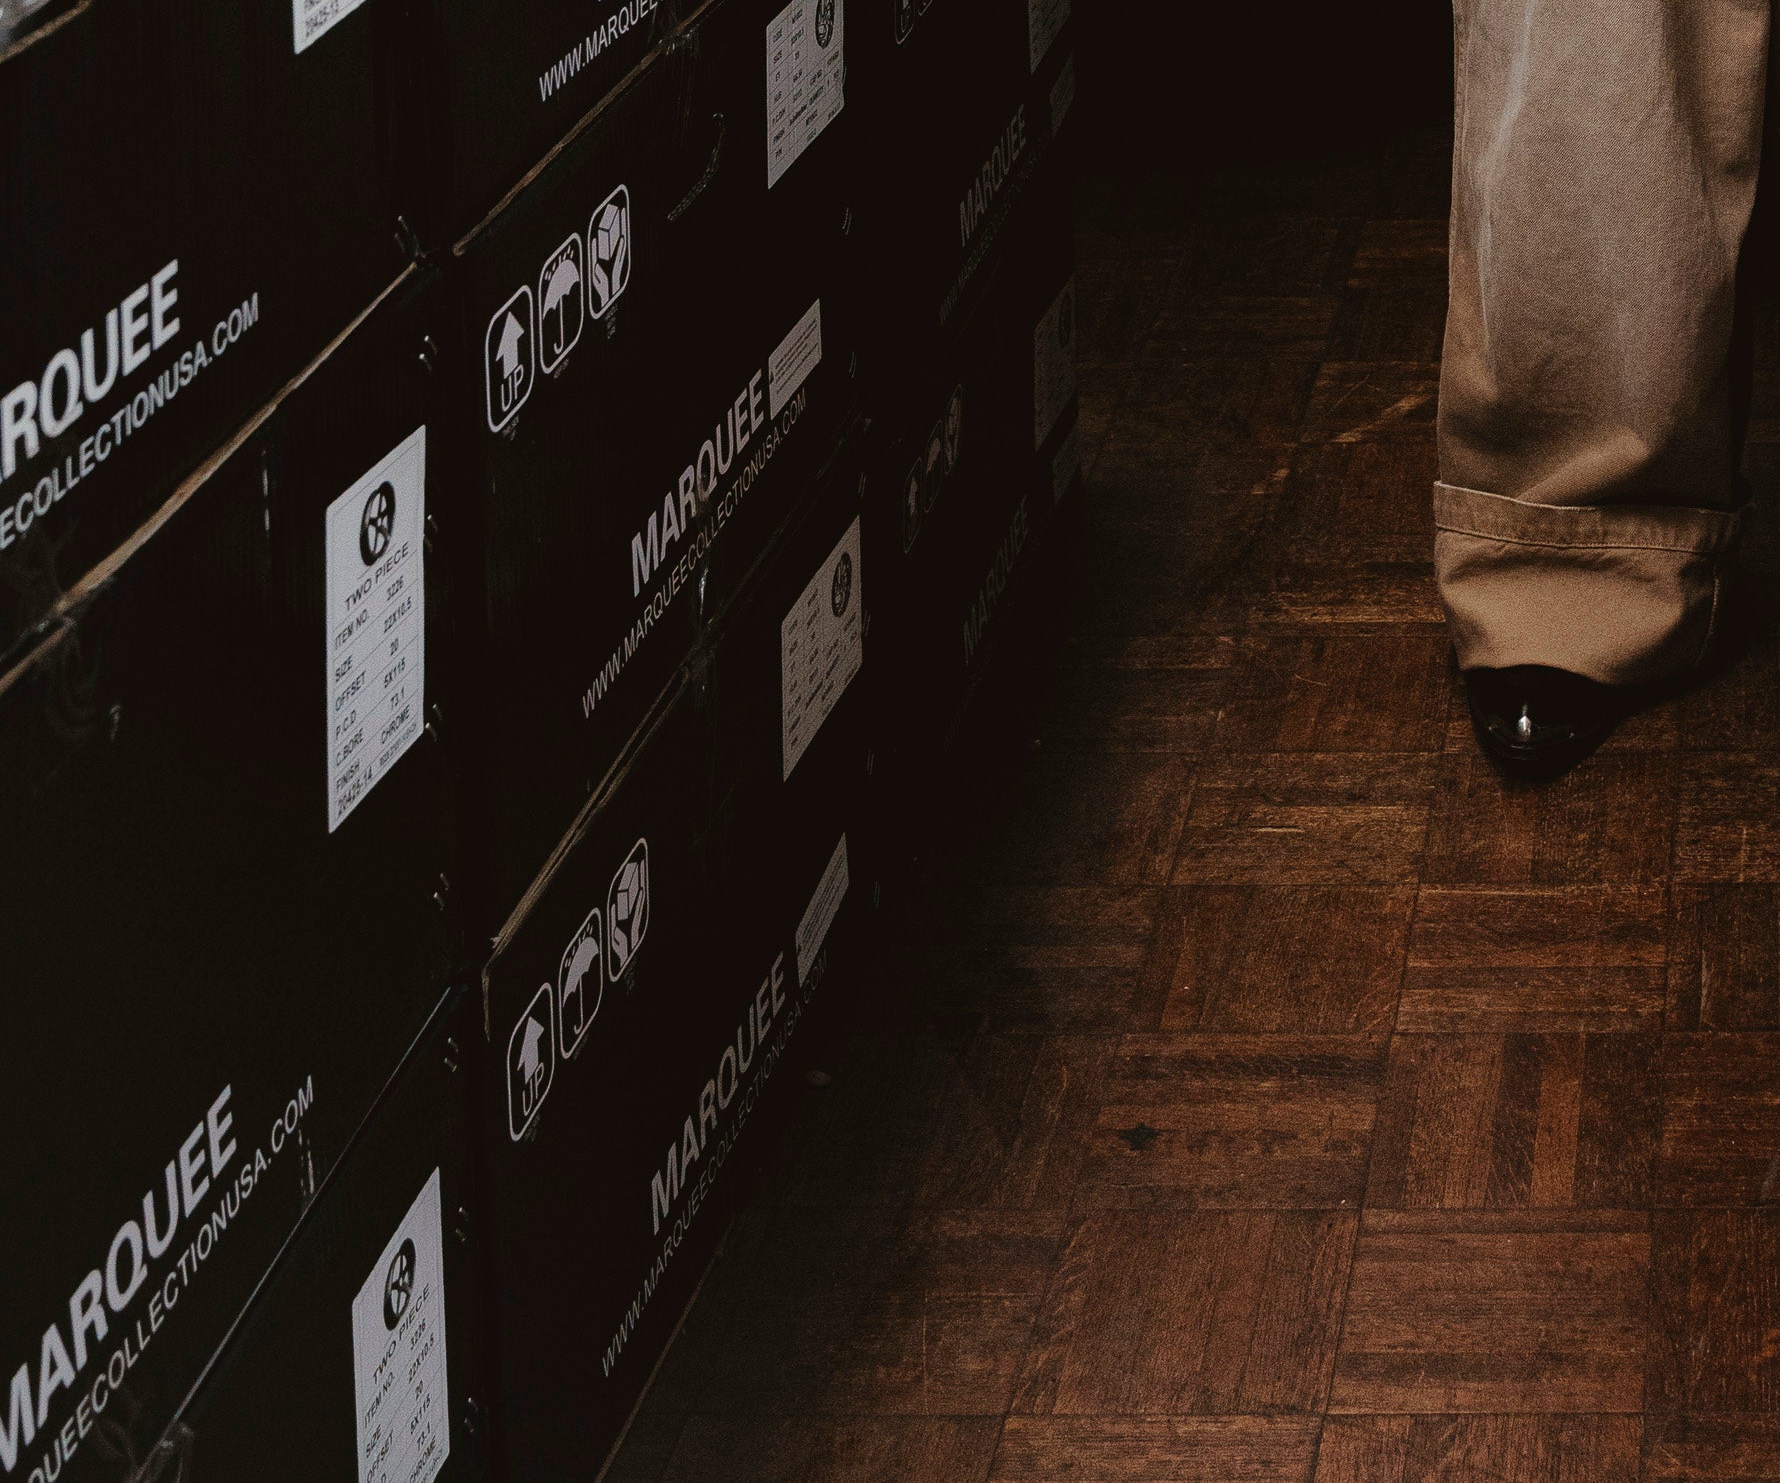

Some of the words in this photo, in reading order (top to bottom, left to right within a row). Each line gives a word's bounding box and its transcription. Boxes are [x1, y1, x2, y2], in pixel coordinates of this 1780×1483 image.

[959, 103, 1026, 247] MARQUEE
[0, 258, 181, 483] RQUEE
[0, 291, 259, 551] ECOLLECTIONUSA.COM
[500, 363, 525, 413] UP
[344, 579, 372, 610] TWO
[375, 541, 409, 583] PIECE
[582, 387, 807, 719] WWW.MARQUEECOLLECTIONUSA.COM
[631, 369, 765, 599] MARQUEE
[962, 494, 1028, 667] MARQUEE
[521, 1061, 545, 1117] UP
[601, 949, 829, 1378] WWW.MARQUEECOLLECTIONUSA.COM
[651, 951, 786, 1237] MARQUEE
[27, 1074, 314, 1483] QUEECOLLECTIONUSA.COM
[372, 1339, 397, 1384] TWO
[398, 1283, 430, 1342] PIECE
